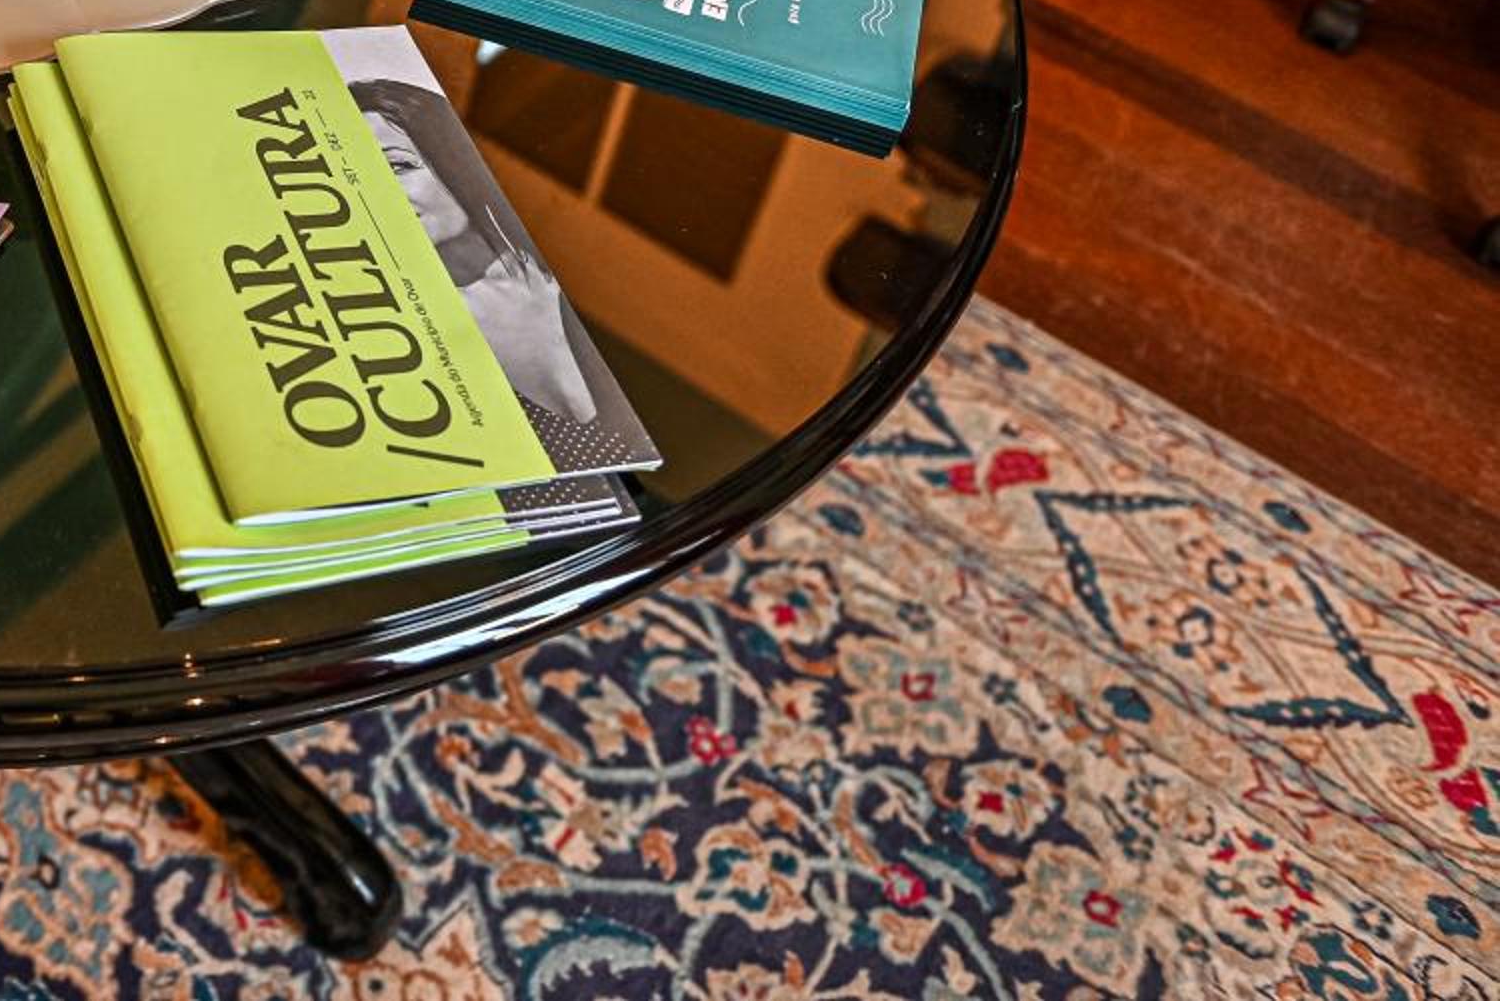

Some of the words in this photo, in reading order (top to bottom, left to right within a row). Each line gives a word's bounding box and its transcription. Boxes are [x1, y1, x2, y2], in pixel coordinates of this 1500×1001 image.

[401, 277, 419, 302] Ovar
[223, 234, 366, 448] OVAR
[455, 383, 484, 428] Agenda
